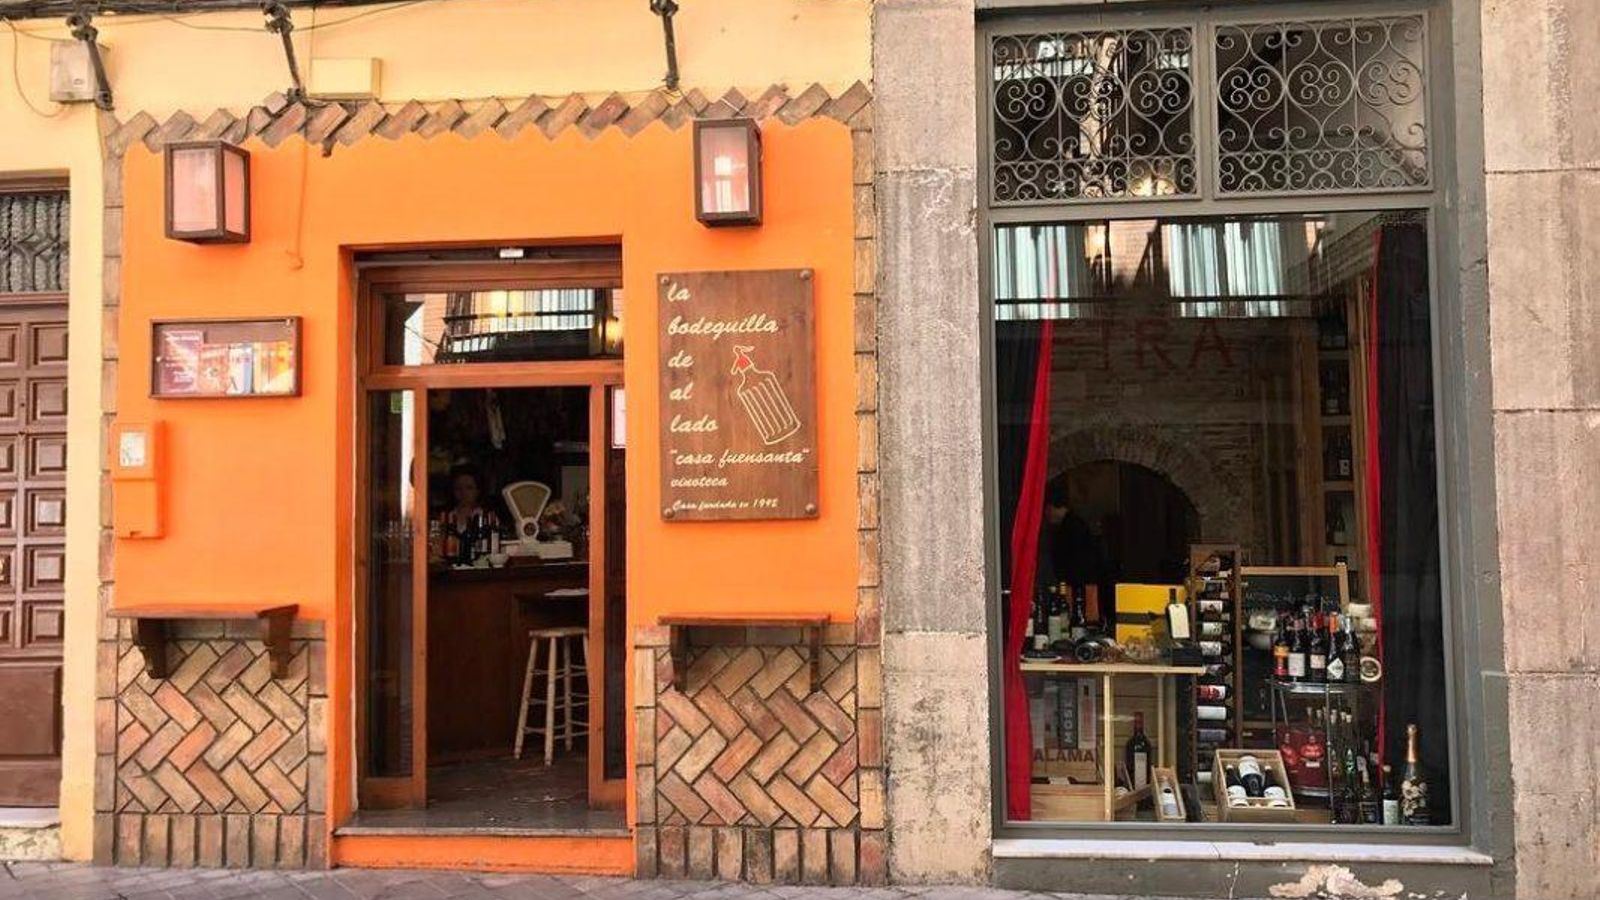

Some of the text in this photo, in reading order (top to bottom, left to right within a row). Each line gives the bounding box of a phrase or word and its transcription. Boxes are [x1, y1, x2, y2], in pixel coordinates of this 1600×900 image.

[667, 283, 692, 302] la
[668, 313, 779, 340] bodeguilla
[668, 350, 694, 368] de
[669, 381, 694, 401] al
[670, 414, 719, 432] lado
[670, 476, 729, 487] vinoteca
[672, 499, 697, 511] Casa
